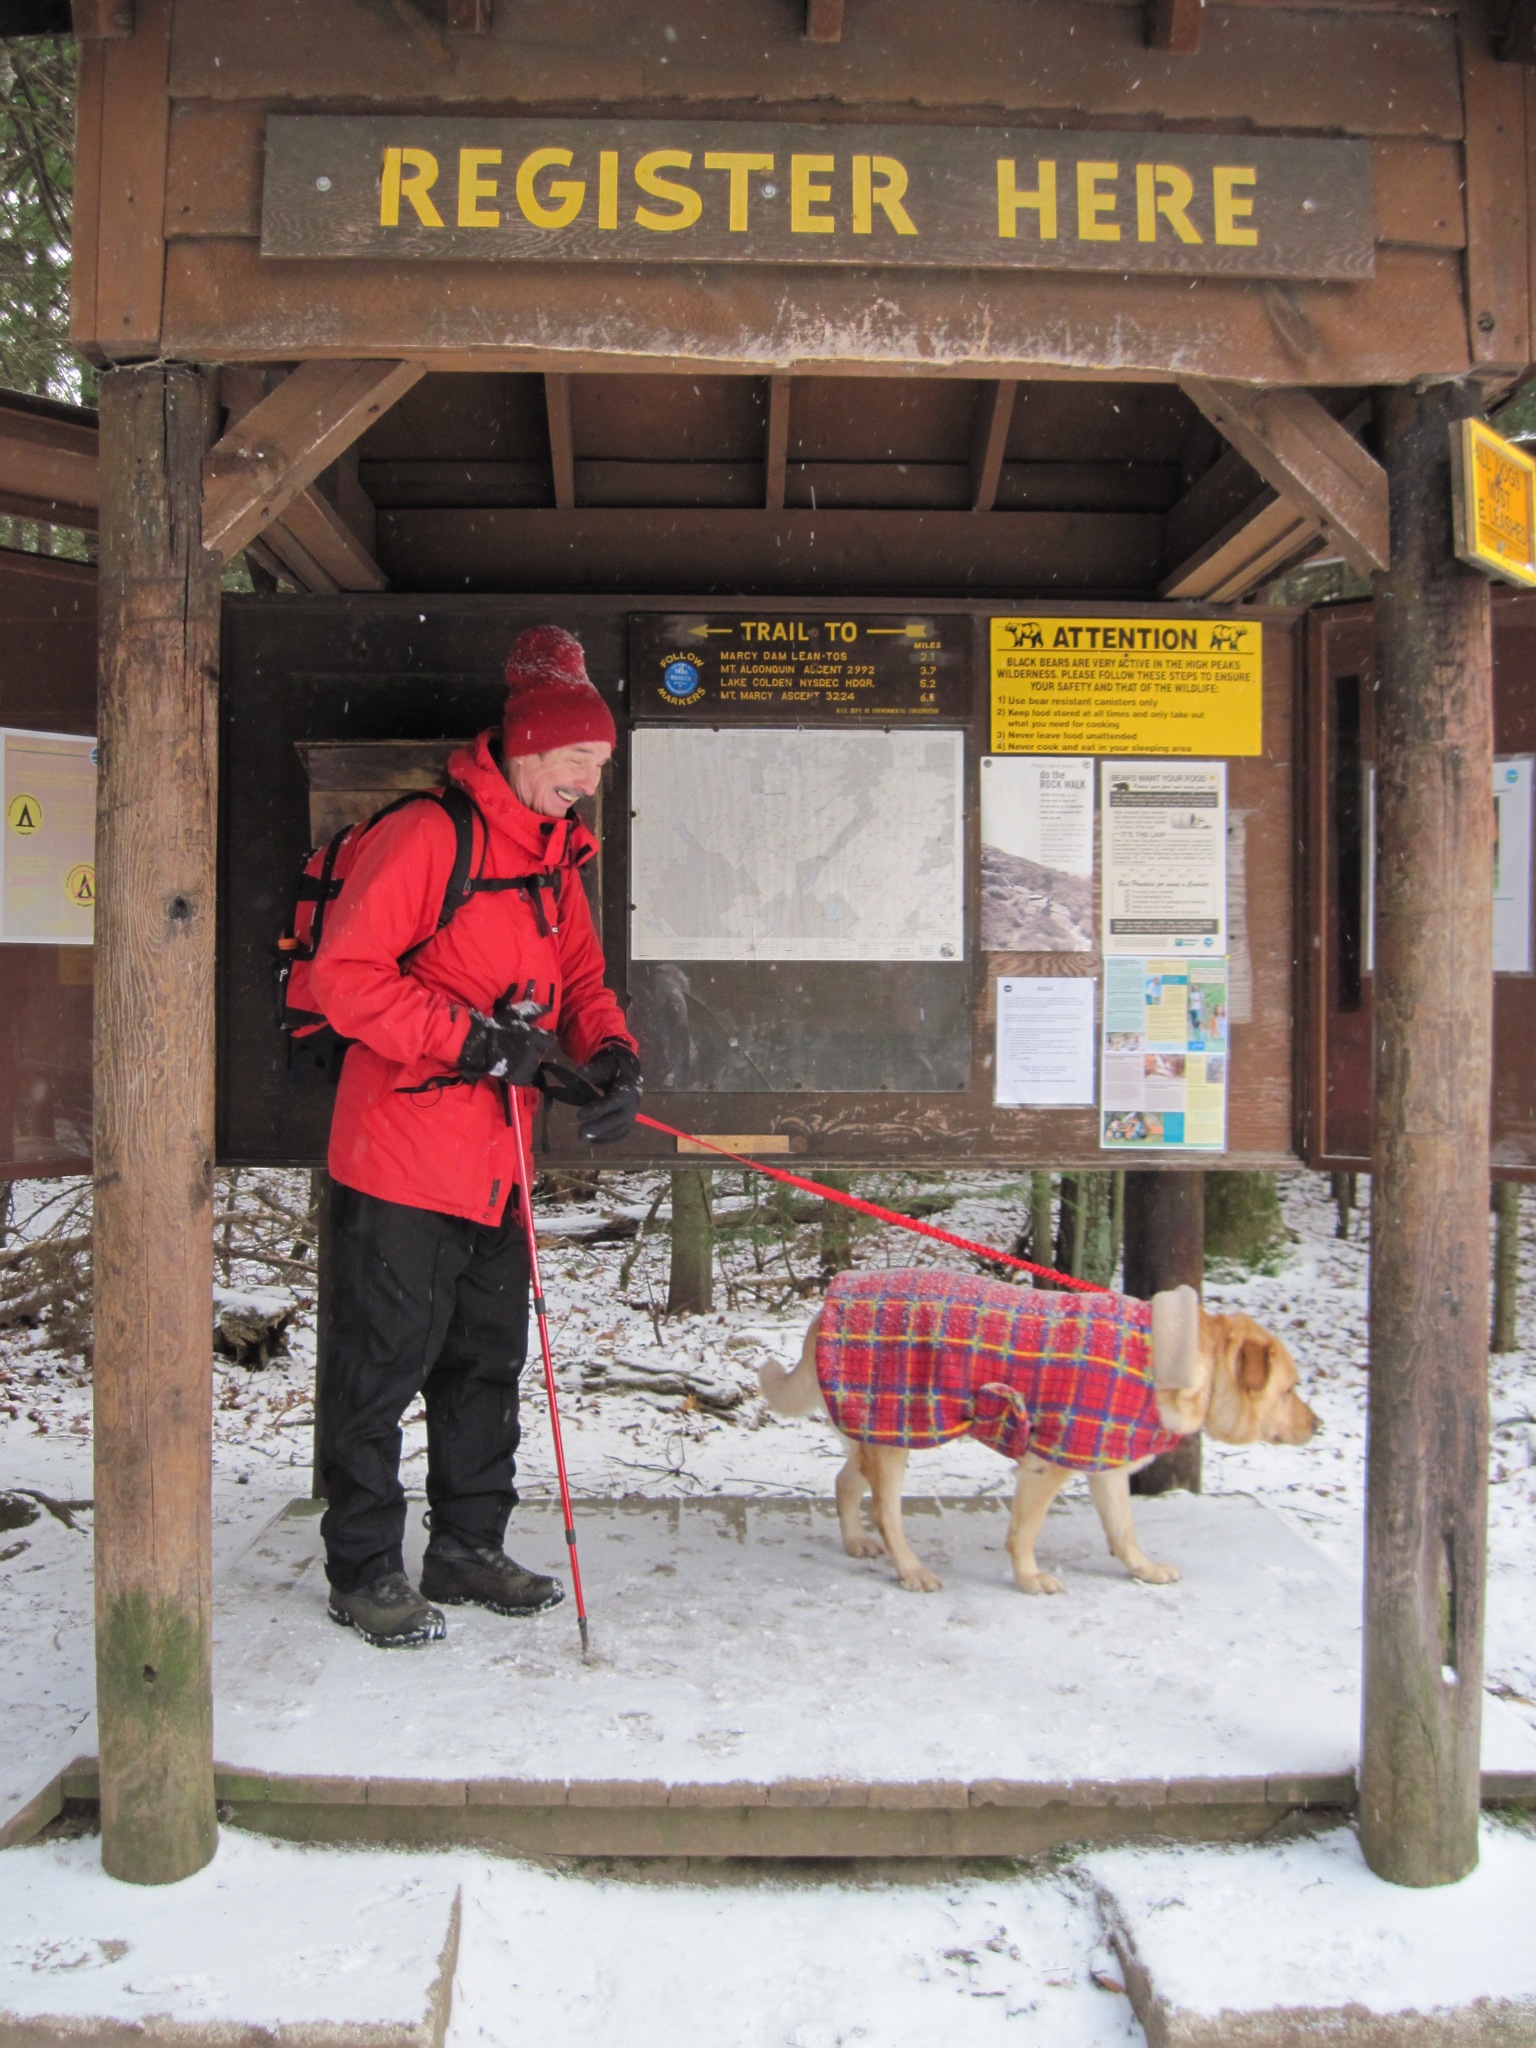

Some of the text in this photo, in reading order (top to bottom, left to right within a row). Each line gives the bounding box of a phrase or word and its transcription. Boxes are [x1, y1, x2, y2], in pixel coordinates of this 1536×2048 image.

[380, 147, 1259, 246] REGISTER HERE
[1495, 458, 1520, 491] DOGS
[1489, 504, 1527, 545] LEASHED
[741, 622, 857, 642] TRAIL TO
[1052, 627, 1197, 650] ATTENTION
[660, 652, 704, 668] FOLLOW
[721, 652, 935, 661] MARCY DAM LEAN-TOS 2.1
[1007, 658, 1240, 669] BLACK BEARS ARE VERY ACTIVE IN THE HIGH PEAKS
[721, 665, 936, 675] MT. ALGONQUIN ASCENT 2992 3.7
[997, 669, 1251, 682] WILDERNESS. PLEASE FOLLOW THESE STEPS TO ENSURE
[721, 678, 936, 688] LAKE COLDEN NYSDEC HDQR. 5.2
[1031, 682, 1219, 693] YOUR SAFETY AND THAT OF THE WILDLIFE:
[657, 687, 706, 705] MARKERS
[721, 692, 935, 702] MT. MARCY ASCENT 3224 6.8
[998, 696, 1158, 708] 1) Use bear resistant canisters only
[997, 708, 1005, 716] 2)
[1008, 709, 1029, 718] Keep
[1032, 709, 1051, 717] food
[1054, 709, 1079, 717] stored
[1132, 710, 1147, 718] and
[1151, 710, 1167, 719] only
[1008, 720, 1119, 730] what you need for cooking
[997, 731, 1005, 740] 3)
[1008, 731, 1034, 739] Never
[1086, 732, 1137, 740] unattended
[1037, 743, 1058, 751] cook
[1109, 745, 1129, 753] your
[1132, 744, 1169, 753] sleeping
[1040, 770, 1065, 779] do the
[1040, 780, 1085, 789] ROCK WALK
